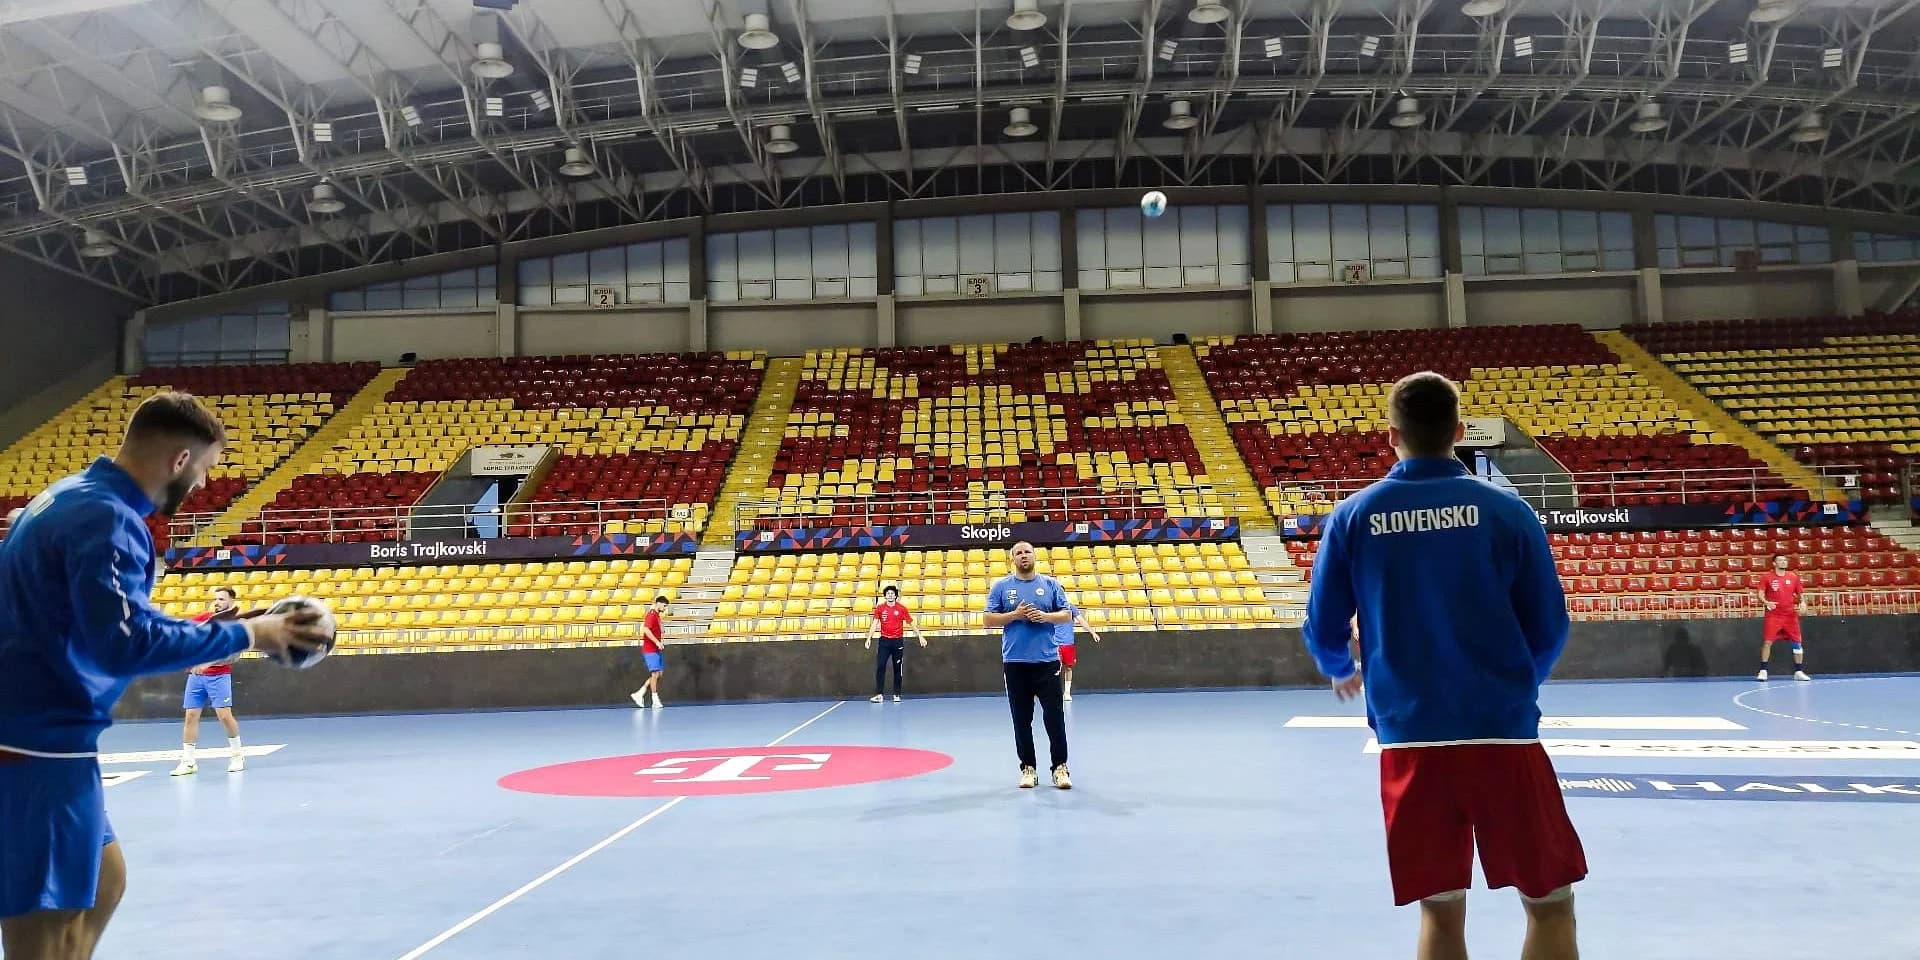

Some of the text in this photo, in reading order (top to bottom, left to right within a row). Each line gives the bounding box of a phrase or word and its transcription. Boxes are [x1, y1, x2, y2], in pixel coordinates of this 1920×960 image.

[974, 284, 982, 294] 3
[600, 294, 608, 304] 2
[1369, 504, 1479, 535] SLOVENSKO
[1550, 508, 1630, 527] Trajkovski
[961, 524, 1011, 541] Skopje
[370, 540, 487, 559] Boris Trajkovski
[634, 753, 833, 784] T
[1648, 780, 1920, 795] HALK
